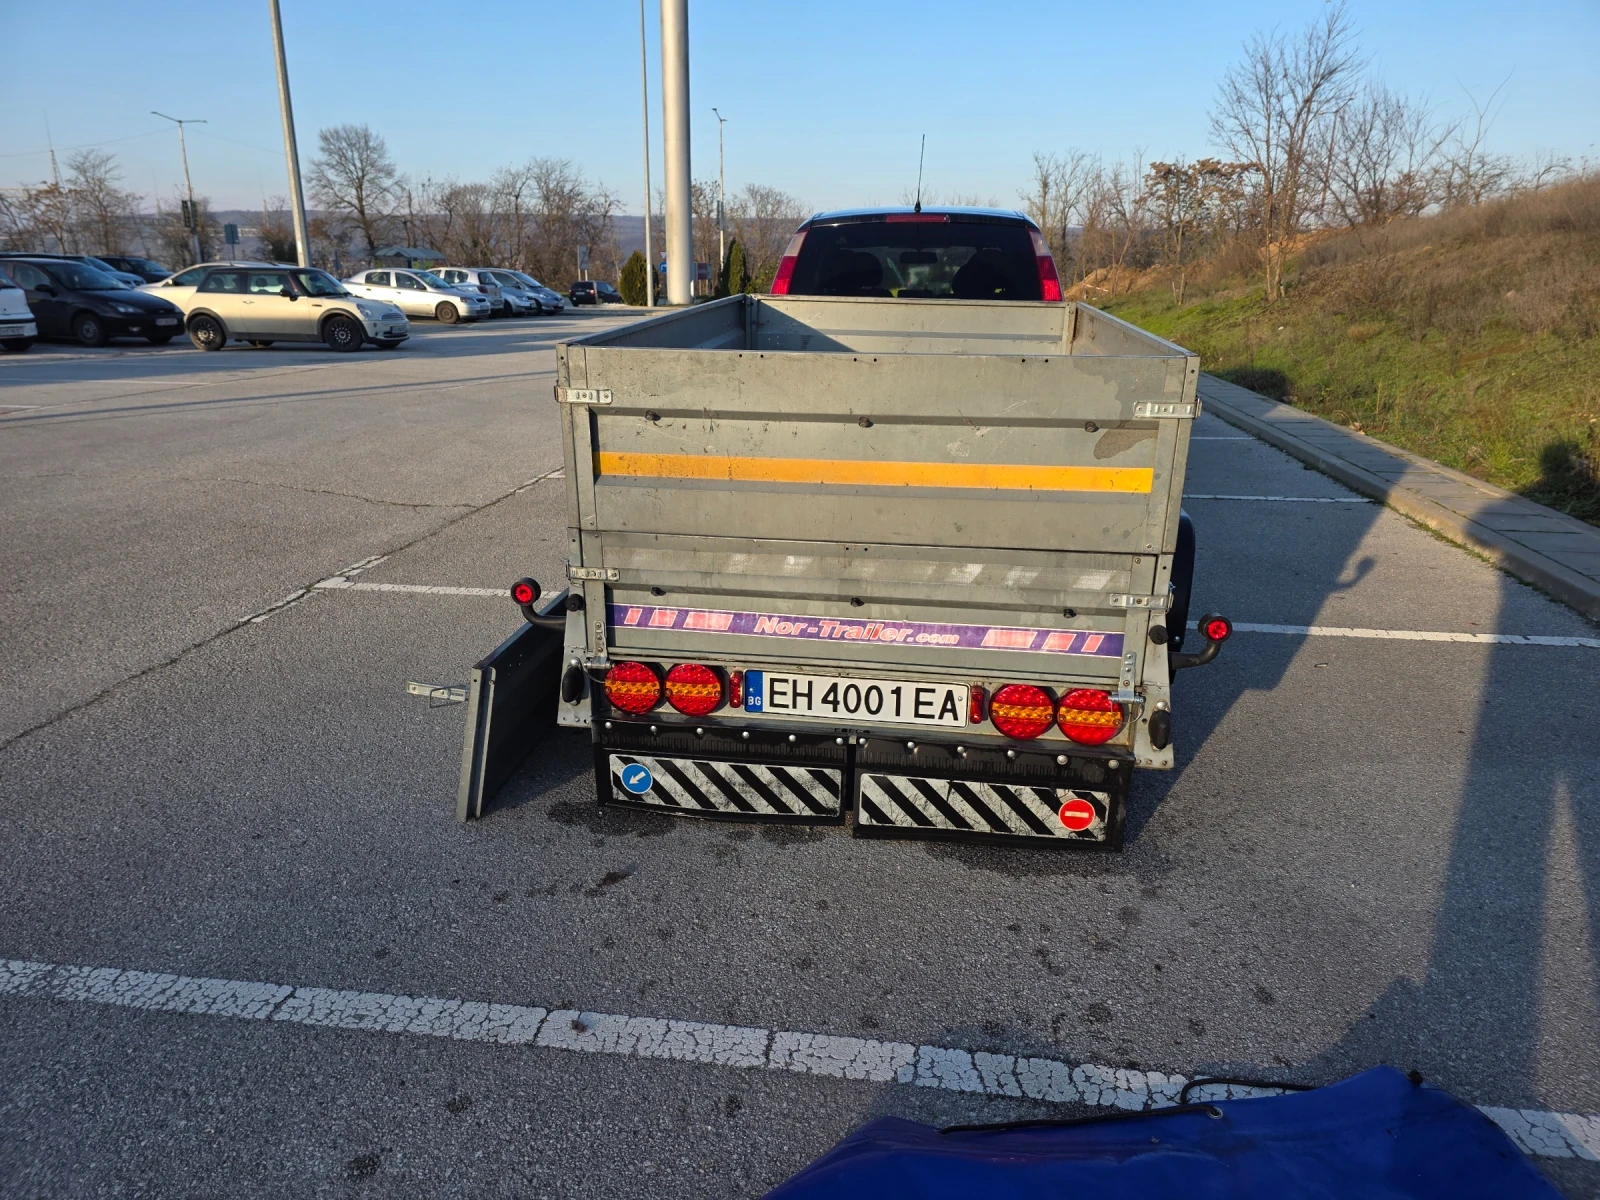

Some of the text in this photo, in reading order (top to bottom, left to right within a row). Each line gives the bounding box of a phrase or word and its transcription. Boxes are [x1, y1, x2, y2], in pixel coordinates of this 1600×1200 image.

[753, 616, 960, 645] Nor-Trailer.com
[747, 696, 762, 706] BG
[769, 677, 959, 721] EH 4001 EA
